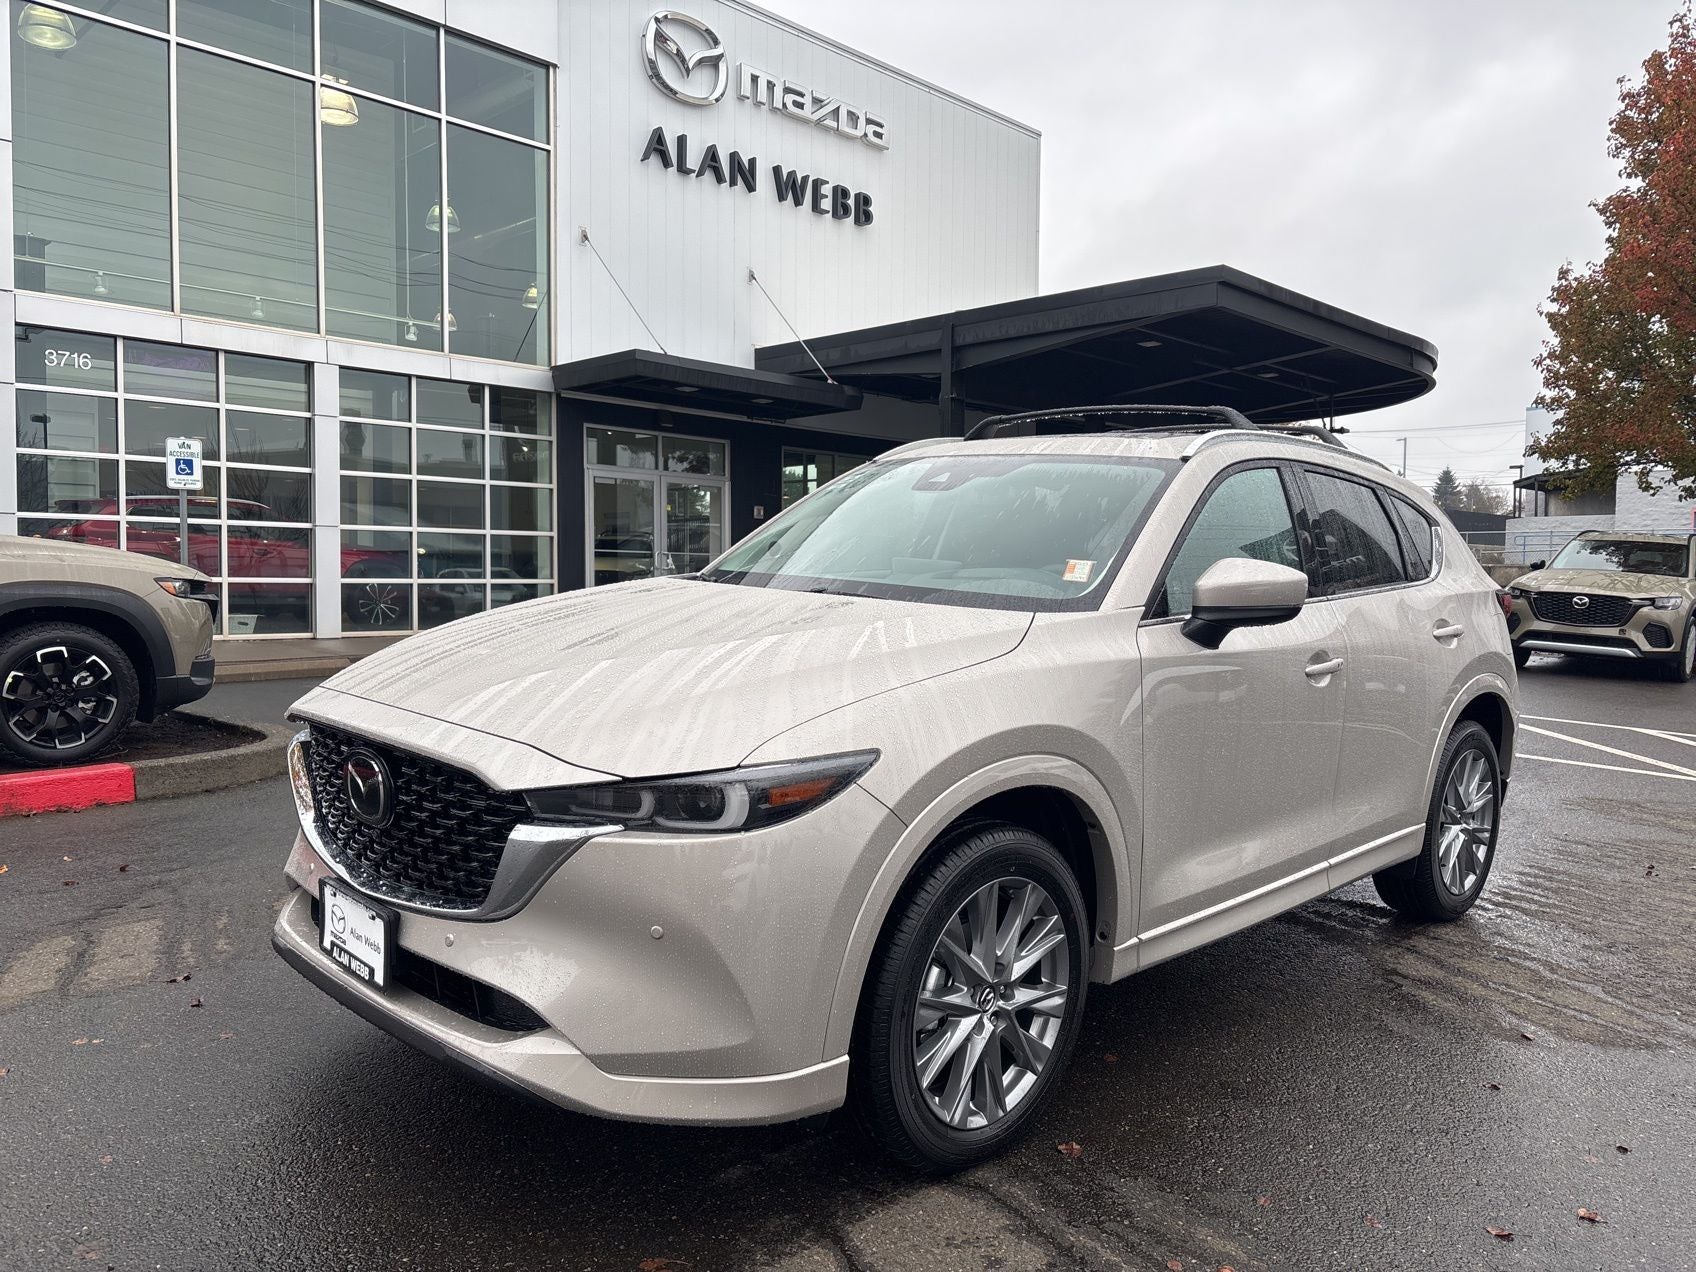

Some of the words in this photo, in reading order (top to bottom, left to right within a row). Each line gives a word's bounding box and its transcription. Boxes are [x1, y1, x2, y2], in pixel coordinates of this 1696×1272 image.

[640, 126, 757, 194] ALAN
[772, 164, 874, 227] WEBB
[44, 349, 92, 370] 3716
[168, 450, 200, 459] ACCESSIBLE
[177, 442, 192, 450] VAN
[349, 927, 364, 943] Alan
[364, 935, 381, 955] Webb
[333, 946, 349, 967] ALAN
[351, 957, 369, 980] WEBB
